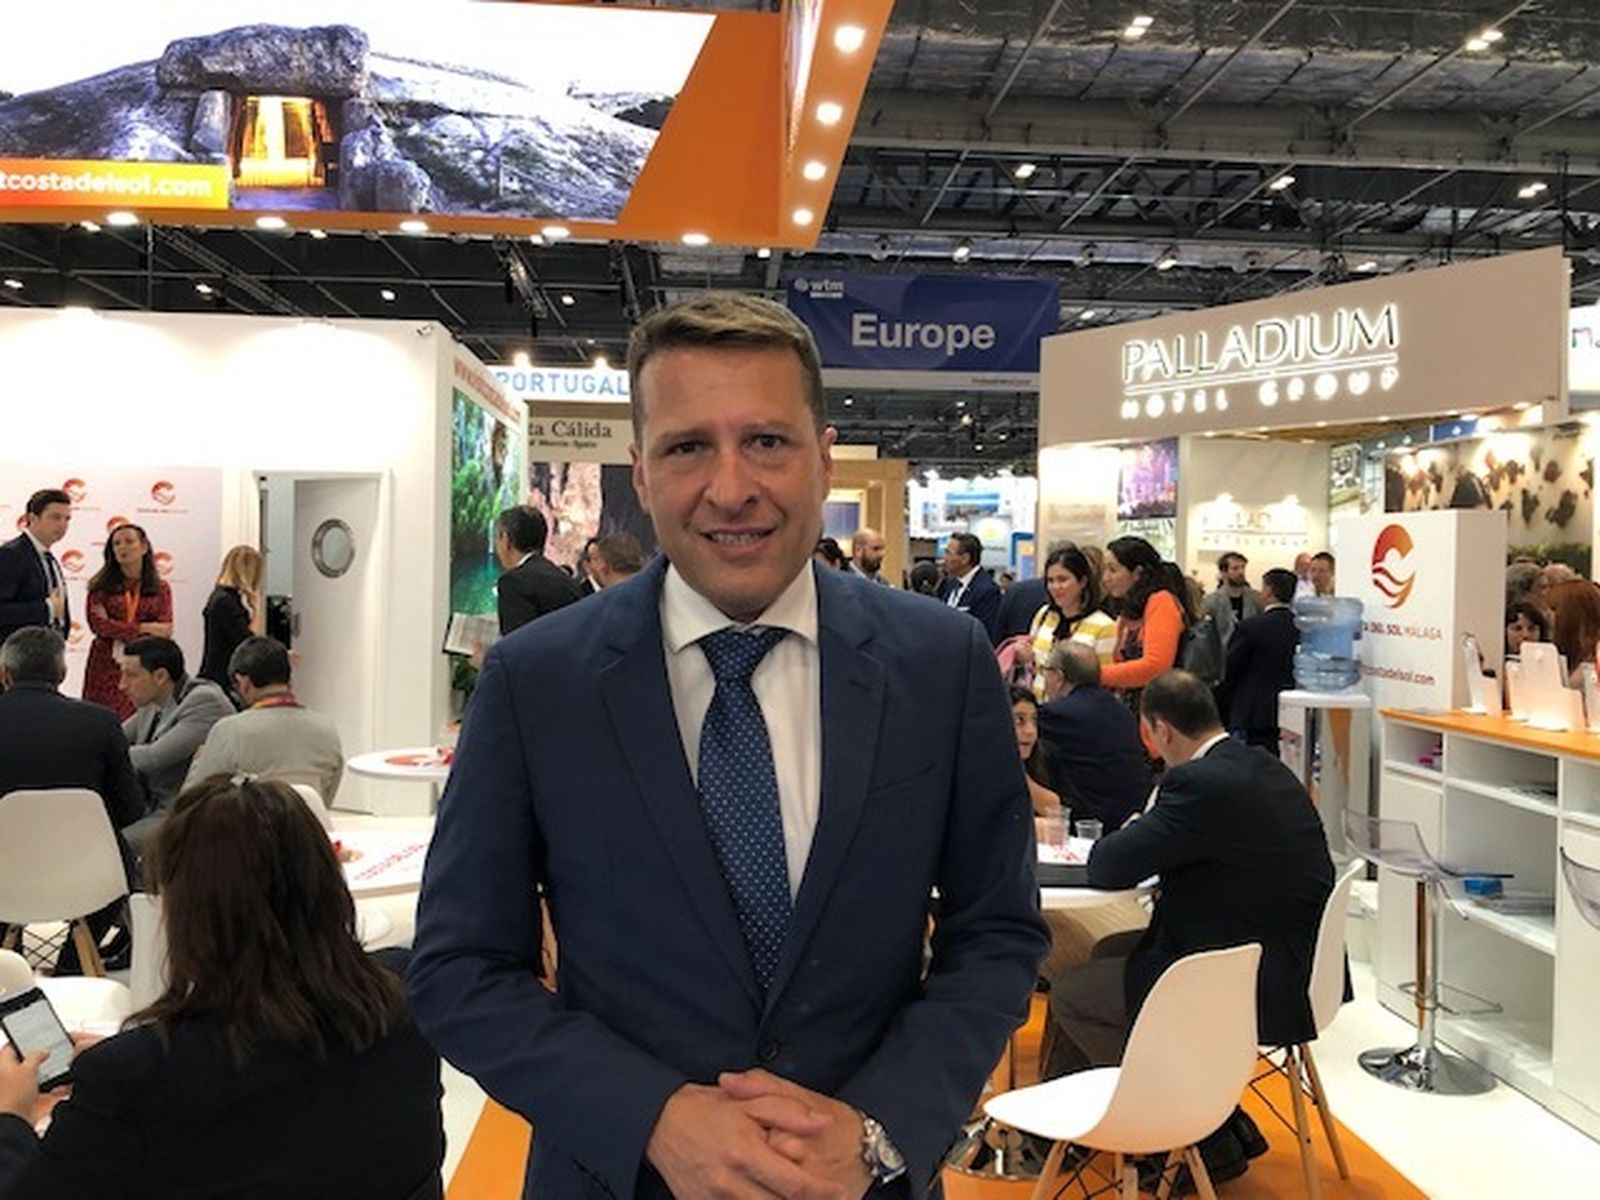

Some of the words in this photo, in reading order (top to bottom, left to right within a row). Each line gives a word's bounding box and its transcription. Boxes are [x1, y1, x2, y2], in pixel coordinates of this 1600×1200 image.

[810, 278, 844, 291] wtm
[852, 313, 995, 356] Europe
[1122, 303, 1399, 383] PALLADIUM
[496, 371, 630, 396] PORTUGAL
[551, 418, 613, 438] Cálida
